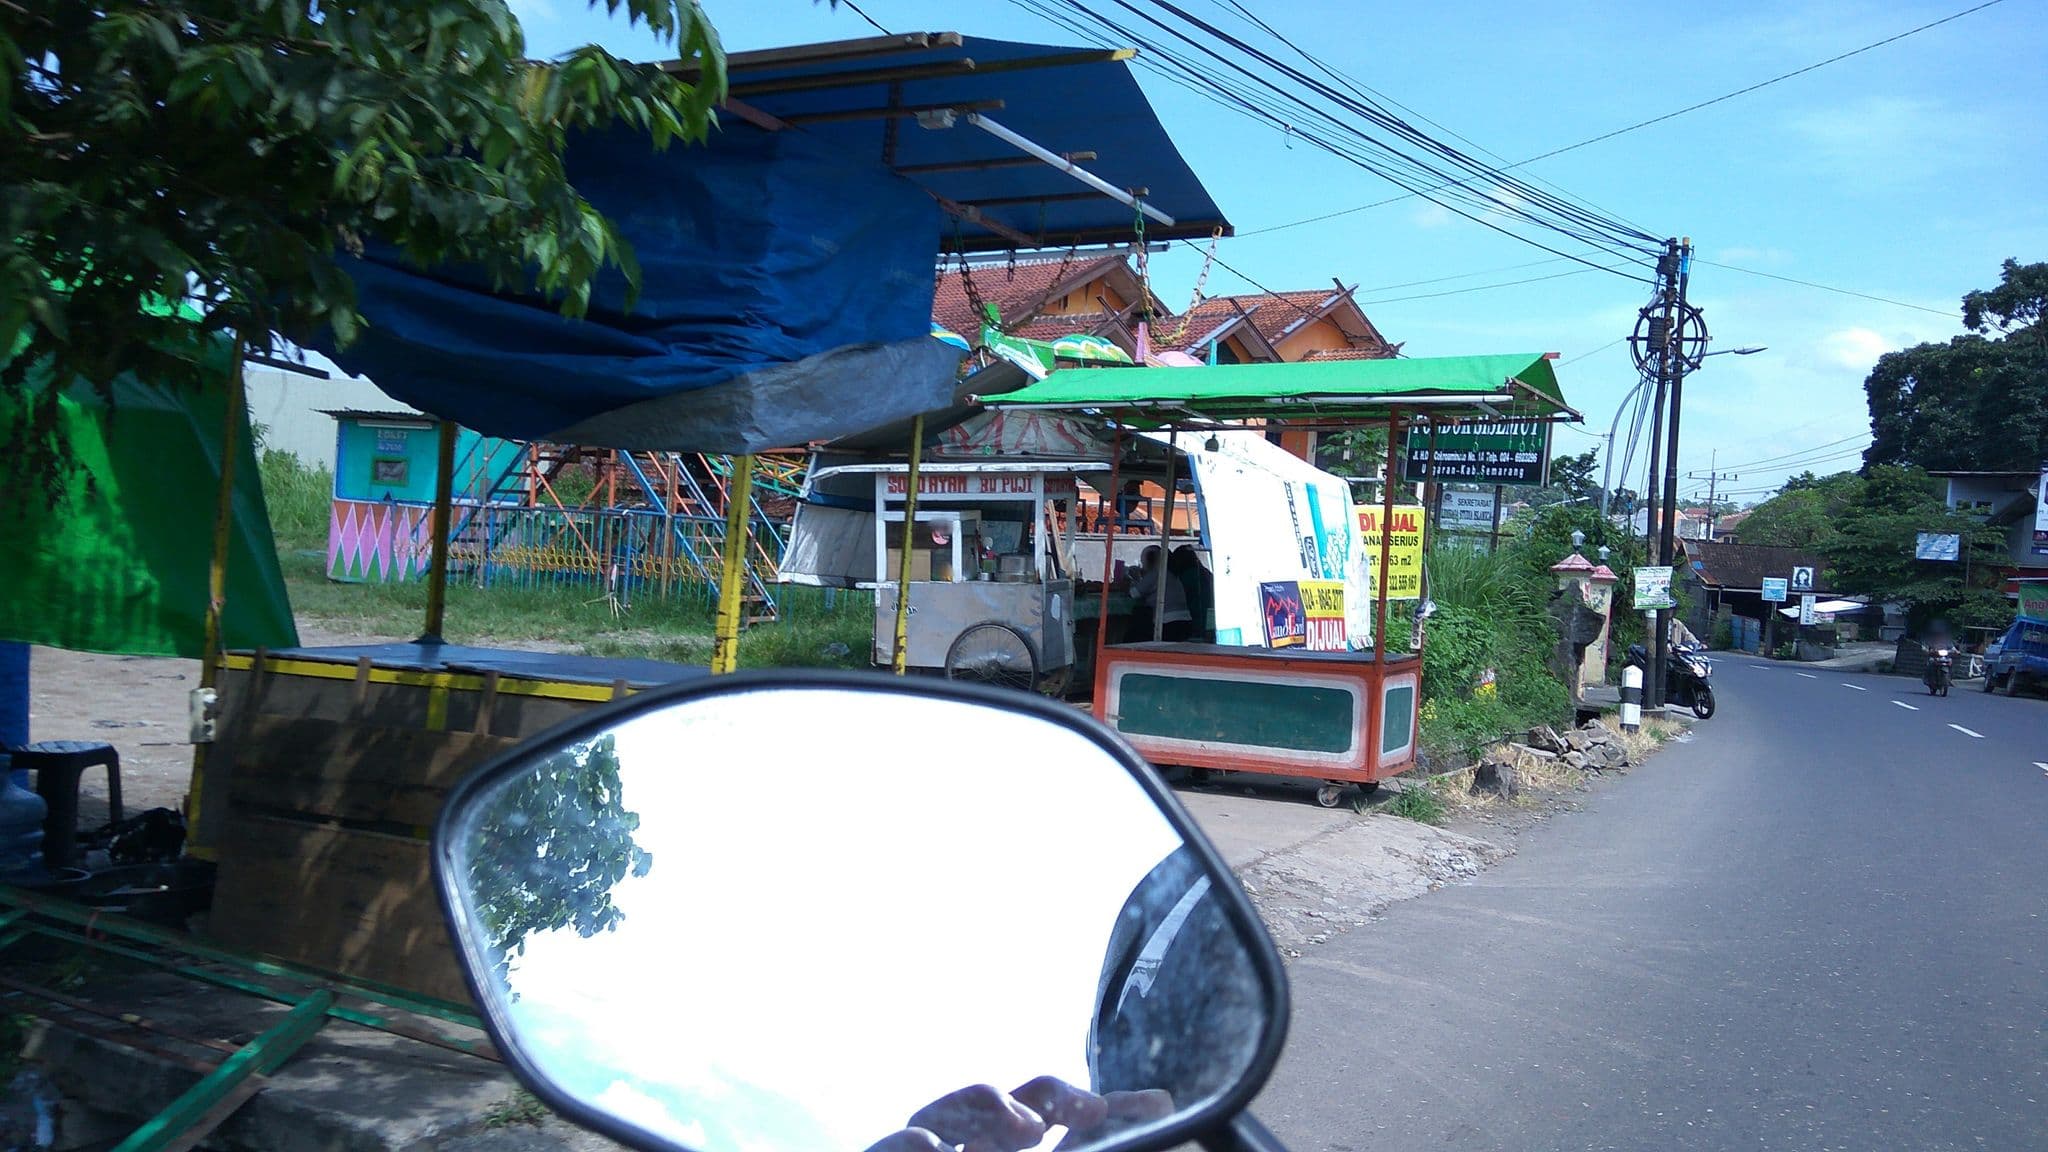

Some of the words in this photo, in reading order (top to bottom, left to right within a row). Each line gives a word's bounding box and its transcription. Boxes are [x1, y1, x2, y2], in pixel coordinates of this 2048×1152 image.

[929, 474, 968, 494] AYAM
[1002, 475, 1034, 494] PUJI
[1359, 513, 1376, 531] DI
[1401, 555, 1412, 566] m2
